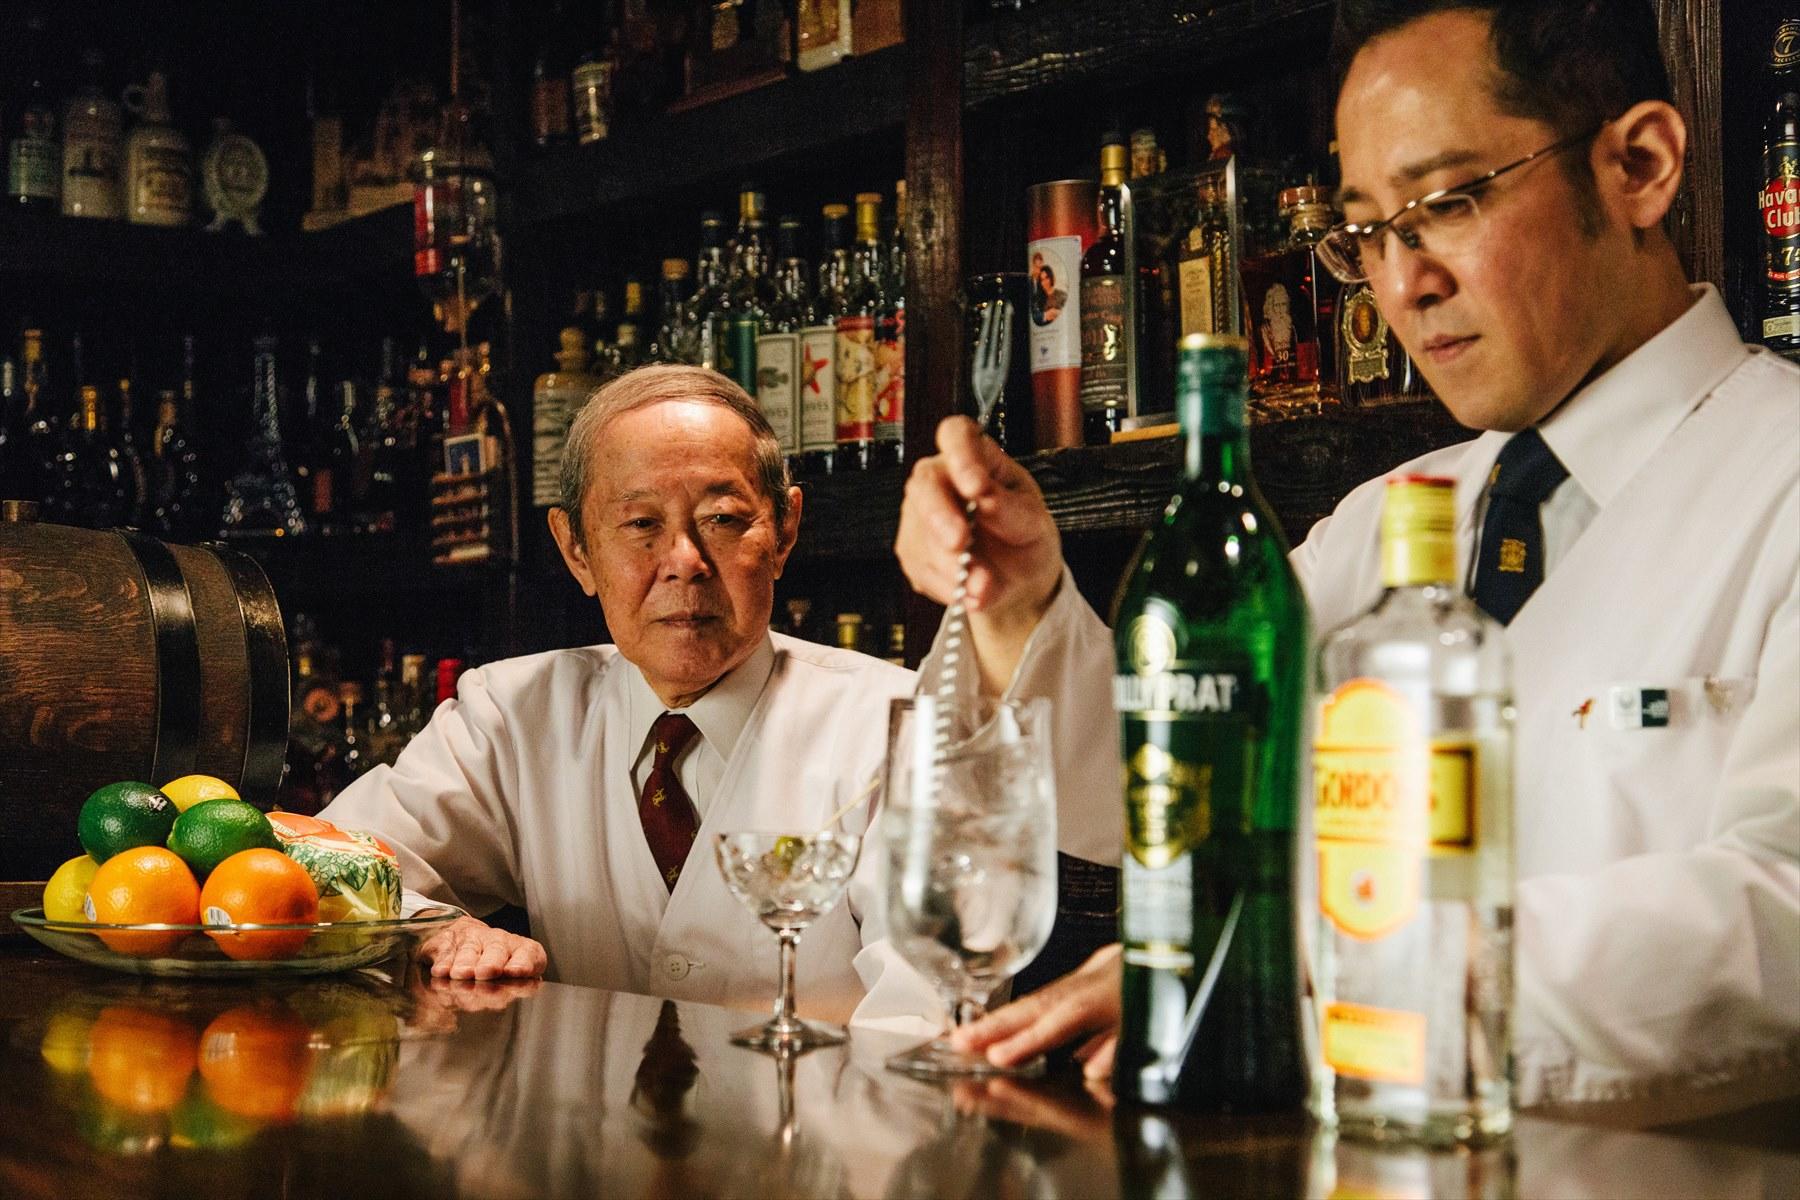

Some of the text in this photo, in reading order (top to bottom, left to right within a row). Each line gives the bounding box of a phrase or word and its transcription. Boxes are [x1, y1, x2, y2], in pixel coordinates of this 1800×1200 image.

[1783, 35, 1795, 54] 7
[1758, 187, 1800, 209] Hava
[1781, 246, 1794, 266] 7
